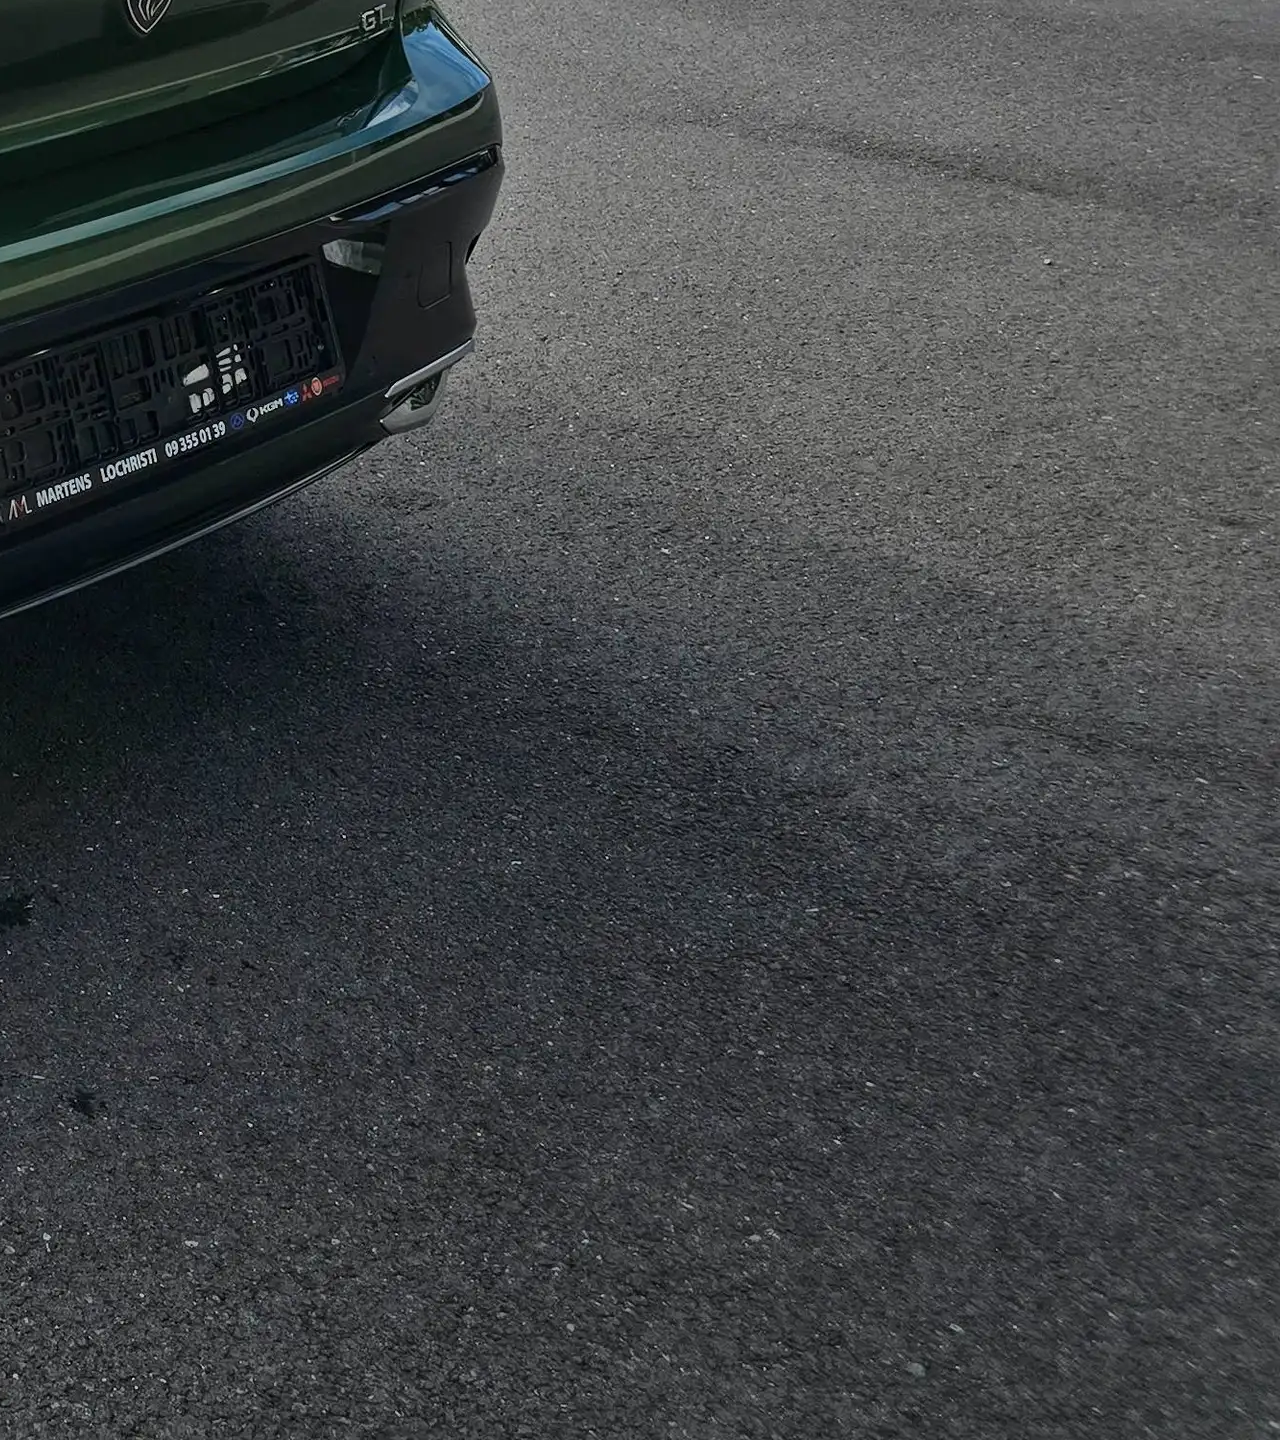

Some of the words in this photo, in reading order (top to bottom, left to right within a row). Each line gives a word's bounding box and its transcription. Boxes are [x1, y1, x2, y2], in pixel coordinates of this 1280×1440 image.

[360, 3, 388, 32] GT
[36, 473, 92, 507] MARTENS
[100, 448, 158, 483] LOCHRISTI
[165, 440, 179, 458] 09
[180, 432, 199, 452] 355
[200, 429, 212, 445] 01
[213, 421, 226, 439] 39
[259, 398, 283, 415] KGM
